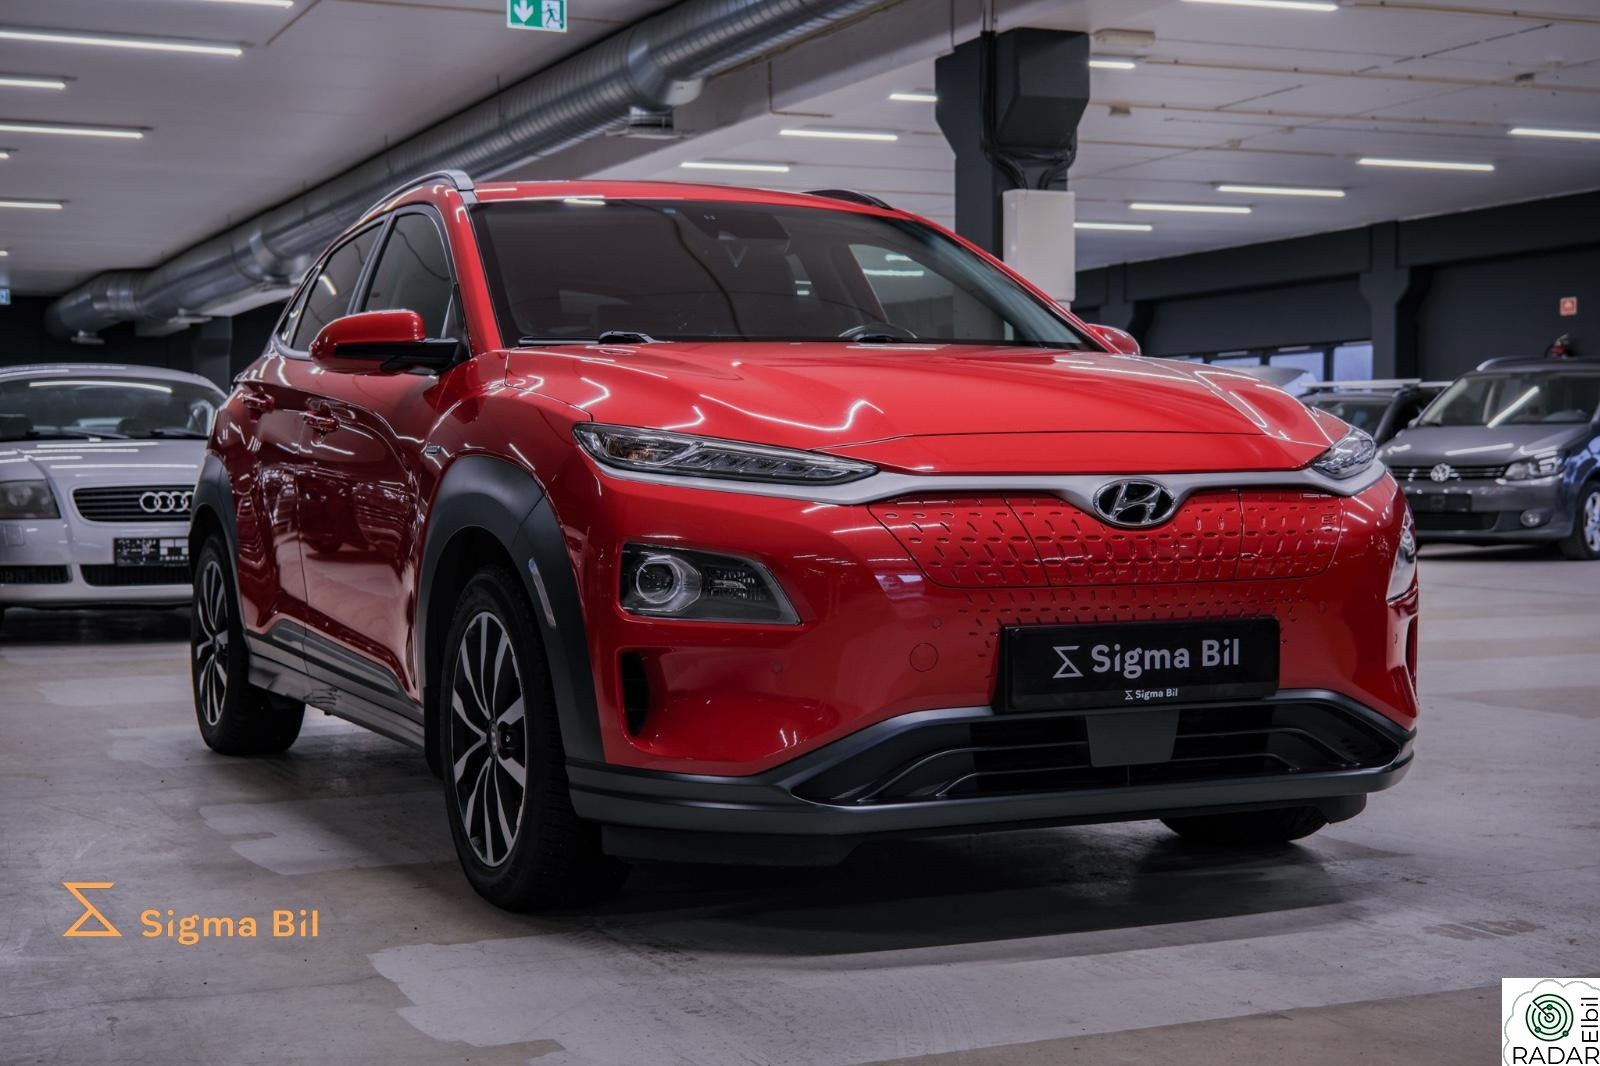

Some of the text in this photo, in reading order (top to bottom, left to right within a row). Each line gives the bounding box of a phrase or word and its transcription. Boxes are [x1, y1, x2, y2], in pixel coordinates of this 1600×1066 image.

[1091, 638, 1239, 679] Sigma Bil
[1135, 688, 1178, 699] Sigma Bil
